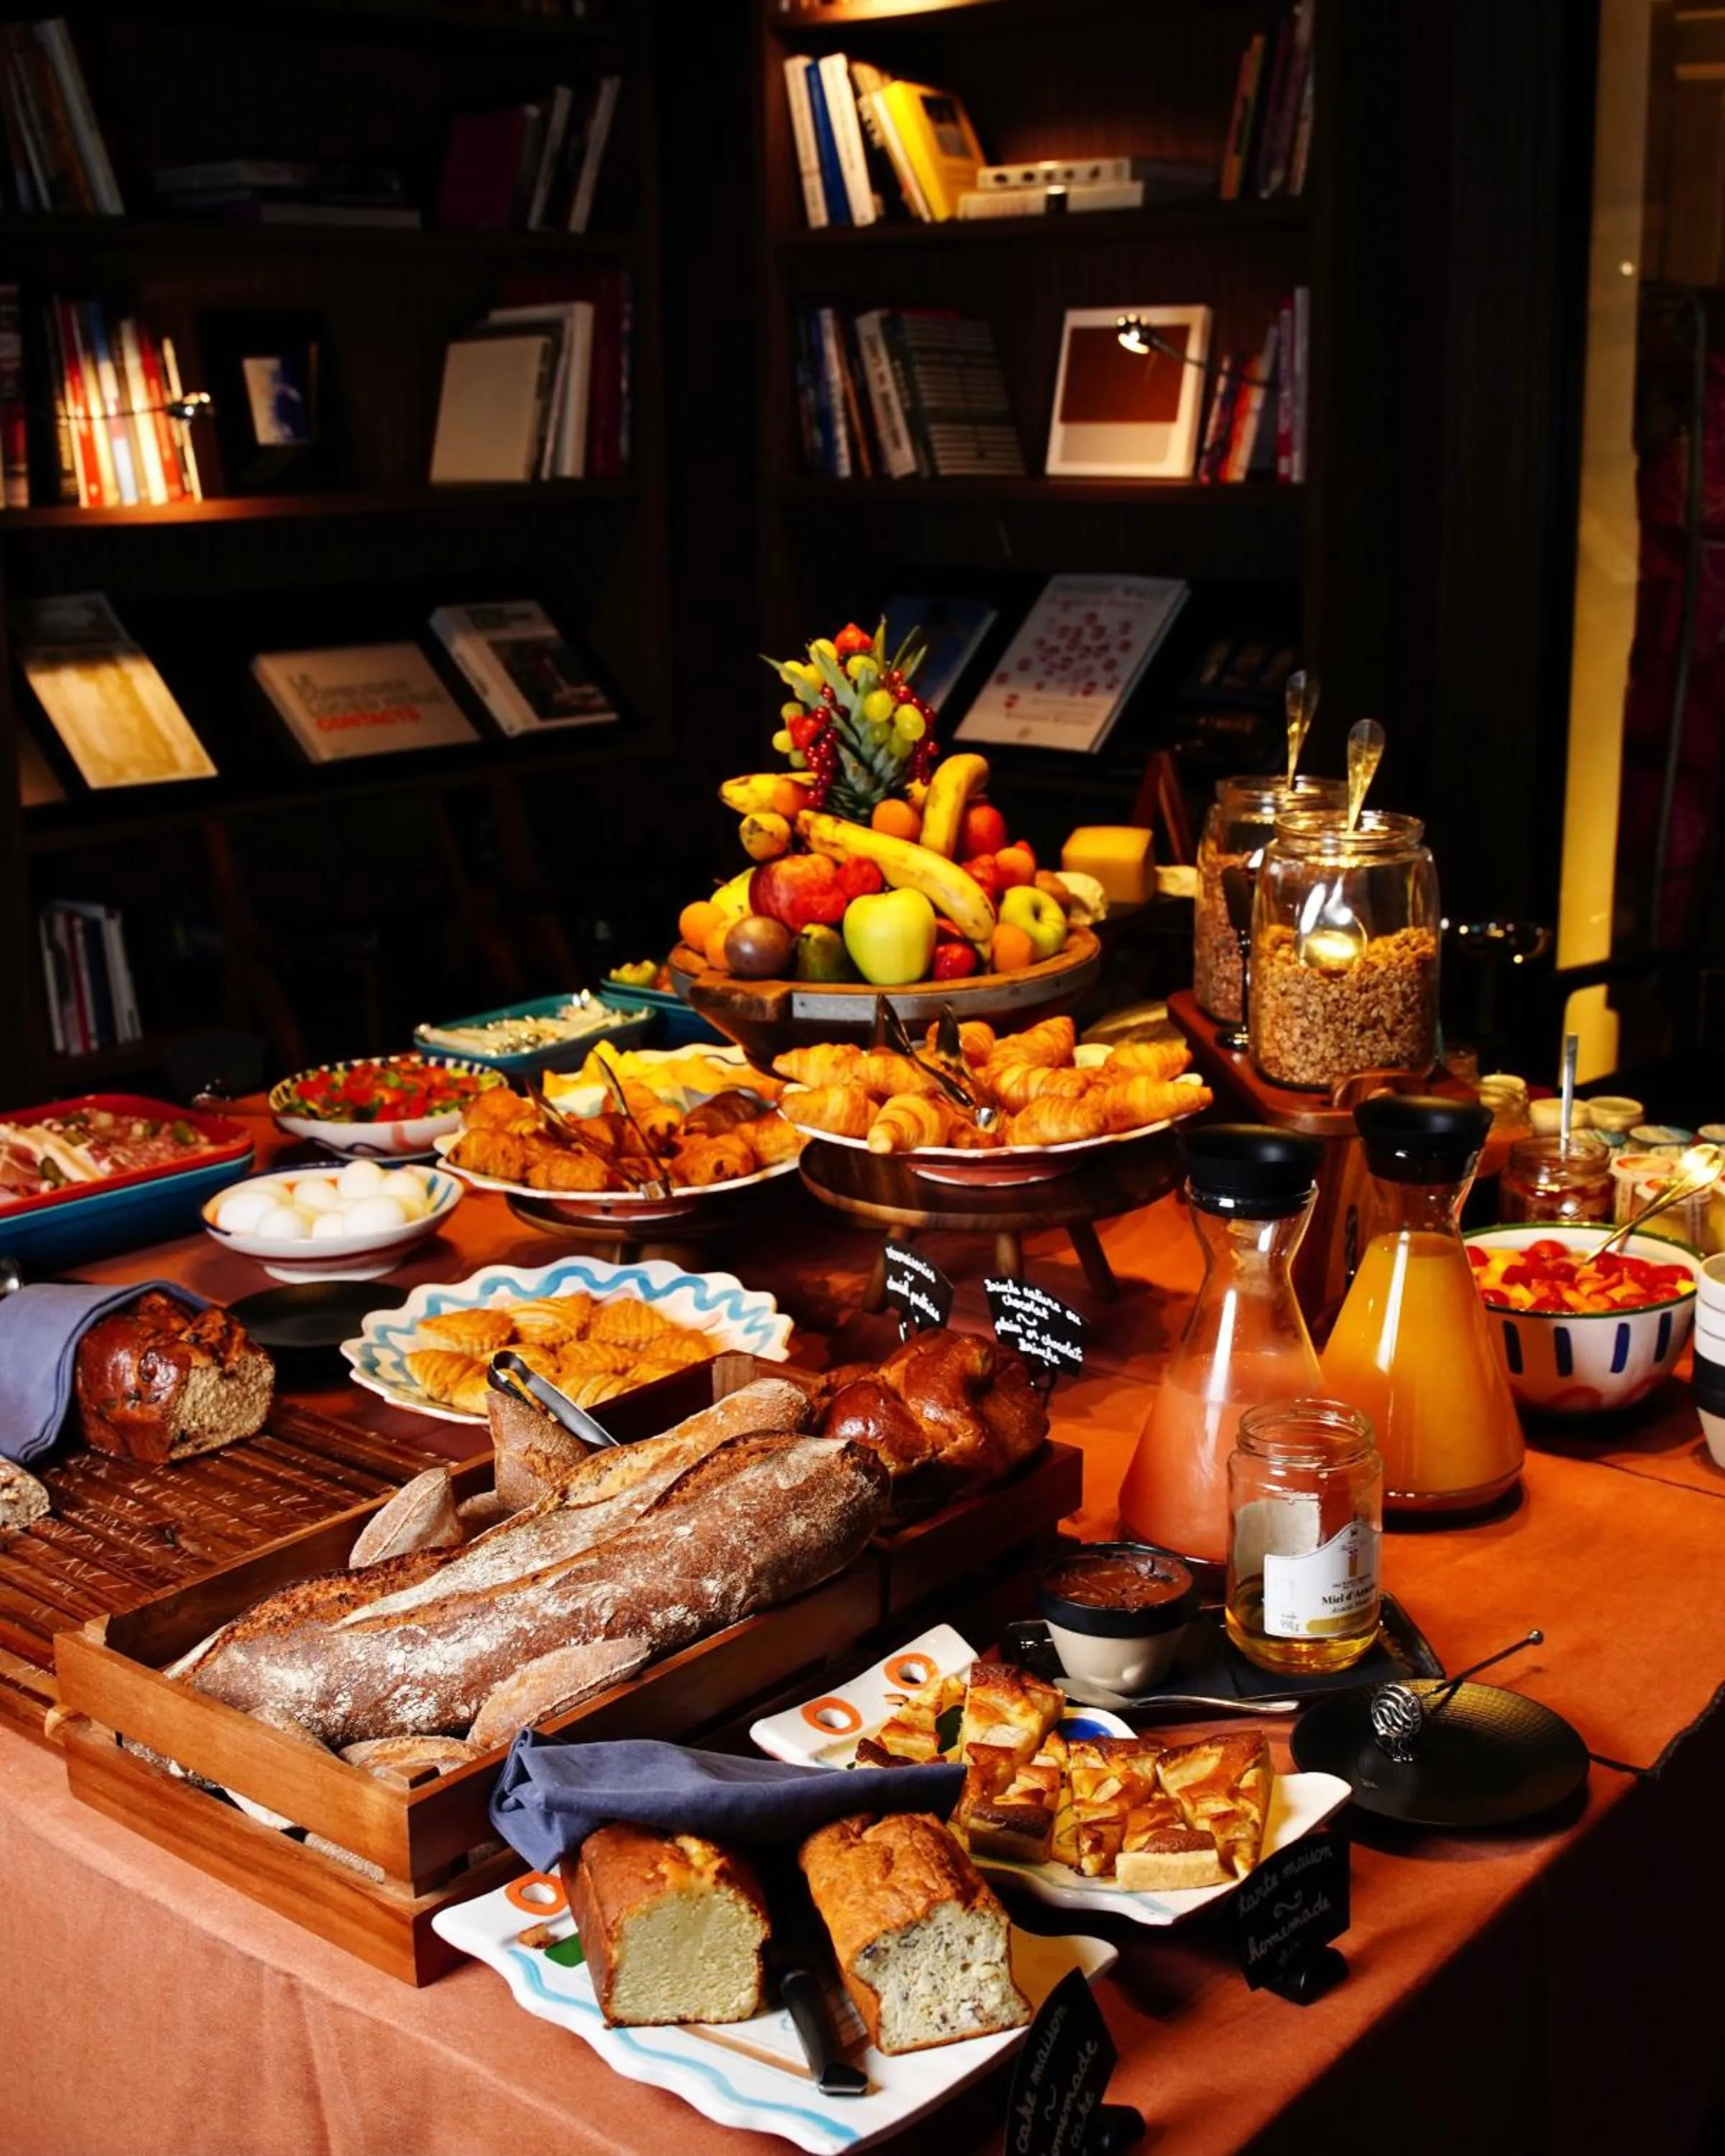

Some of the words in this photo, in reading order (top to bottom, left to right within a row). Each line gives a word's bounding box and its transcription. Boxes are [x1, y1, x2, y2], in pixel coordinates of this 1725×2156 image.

[1321, 1593, 1344, 1605] Miel
[1238, 1871, 1279, 1919] tarte
[1282, 1845, 1333, 1879] maison
[1247, 1890, 1331, 1966] homemade
[1015, 2089, 1038, 2154] cake
[1029, 2003, 1069, 2087] maison
[1039, 2039, 1099, 2156] omemade
[1070, 2090, 1095, 2150] cake
